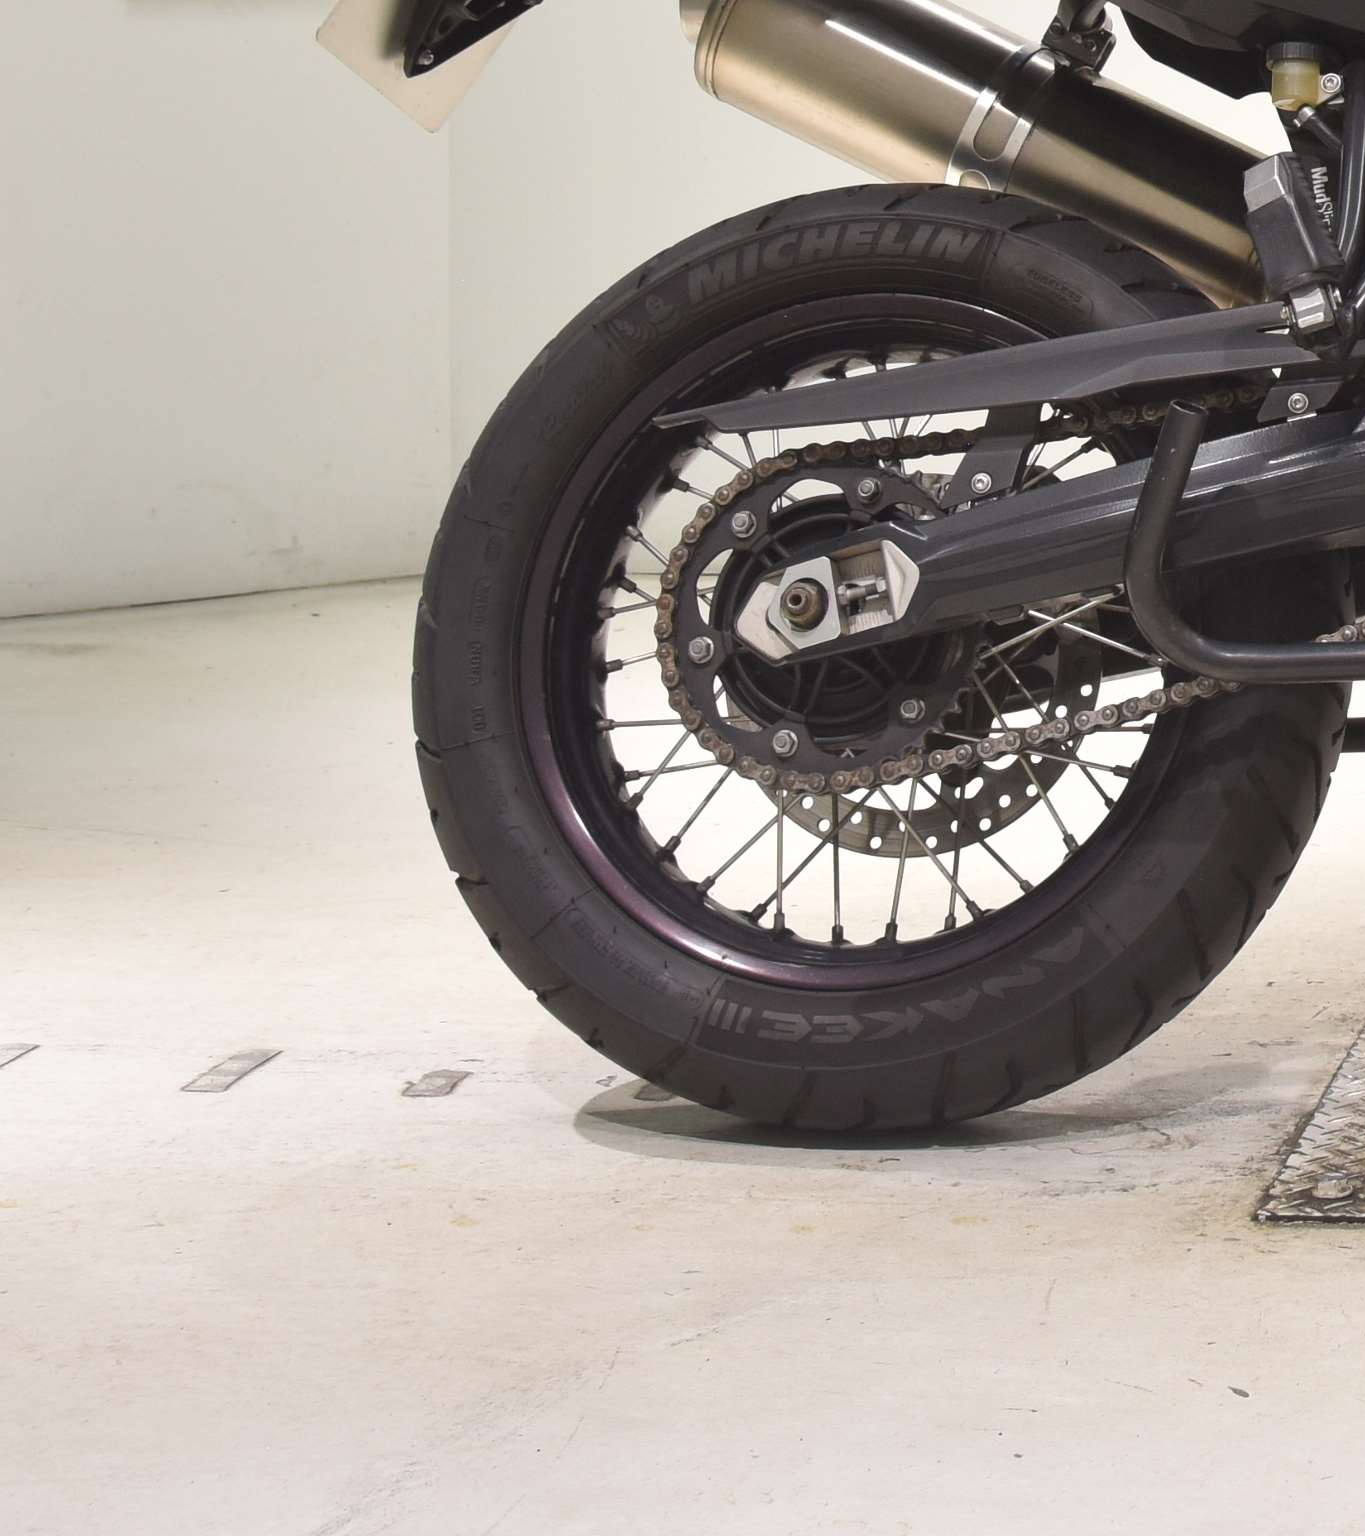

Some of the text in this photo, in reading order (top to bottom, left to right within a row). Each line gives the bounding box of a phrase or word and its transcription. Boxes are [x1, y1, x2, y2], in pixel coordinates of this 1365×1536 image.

[1310, 166, 1334, 233] MudSli
[687, 220, 984, 304] MICHELIN
[757, 924, 1093, 1046] ANAKEE
